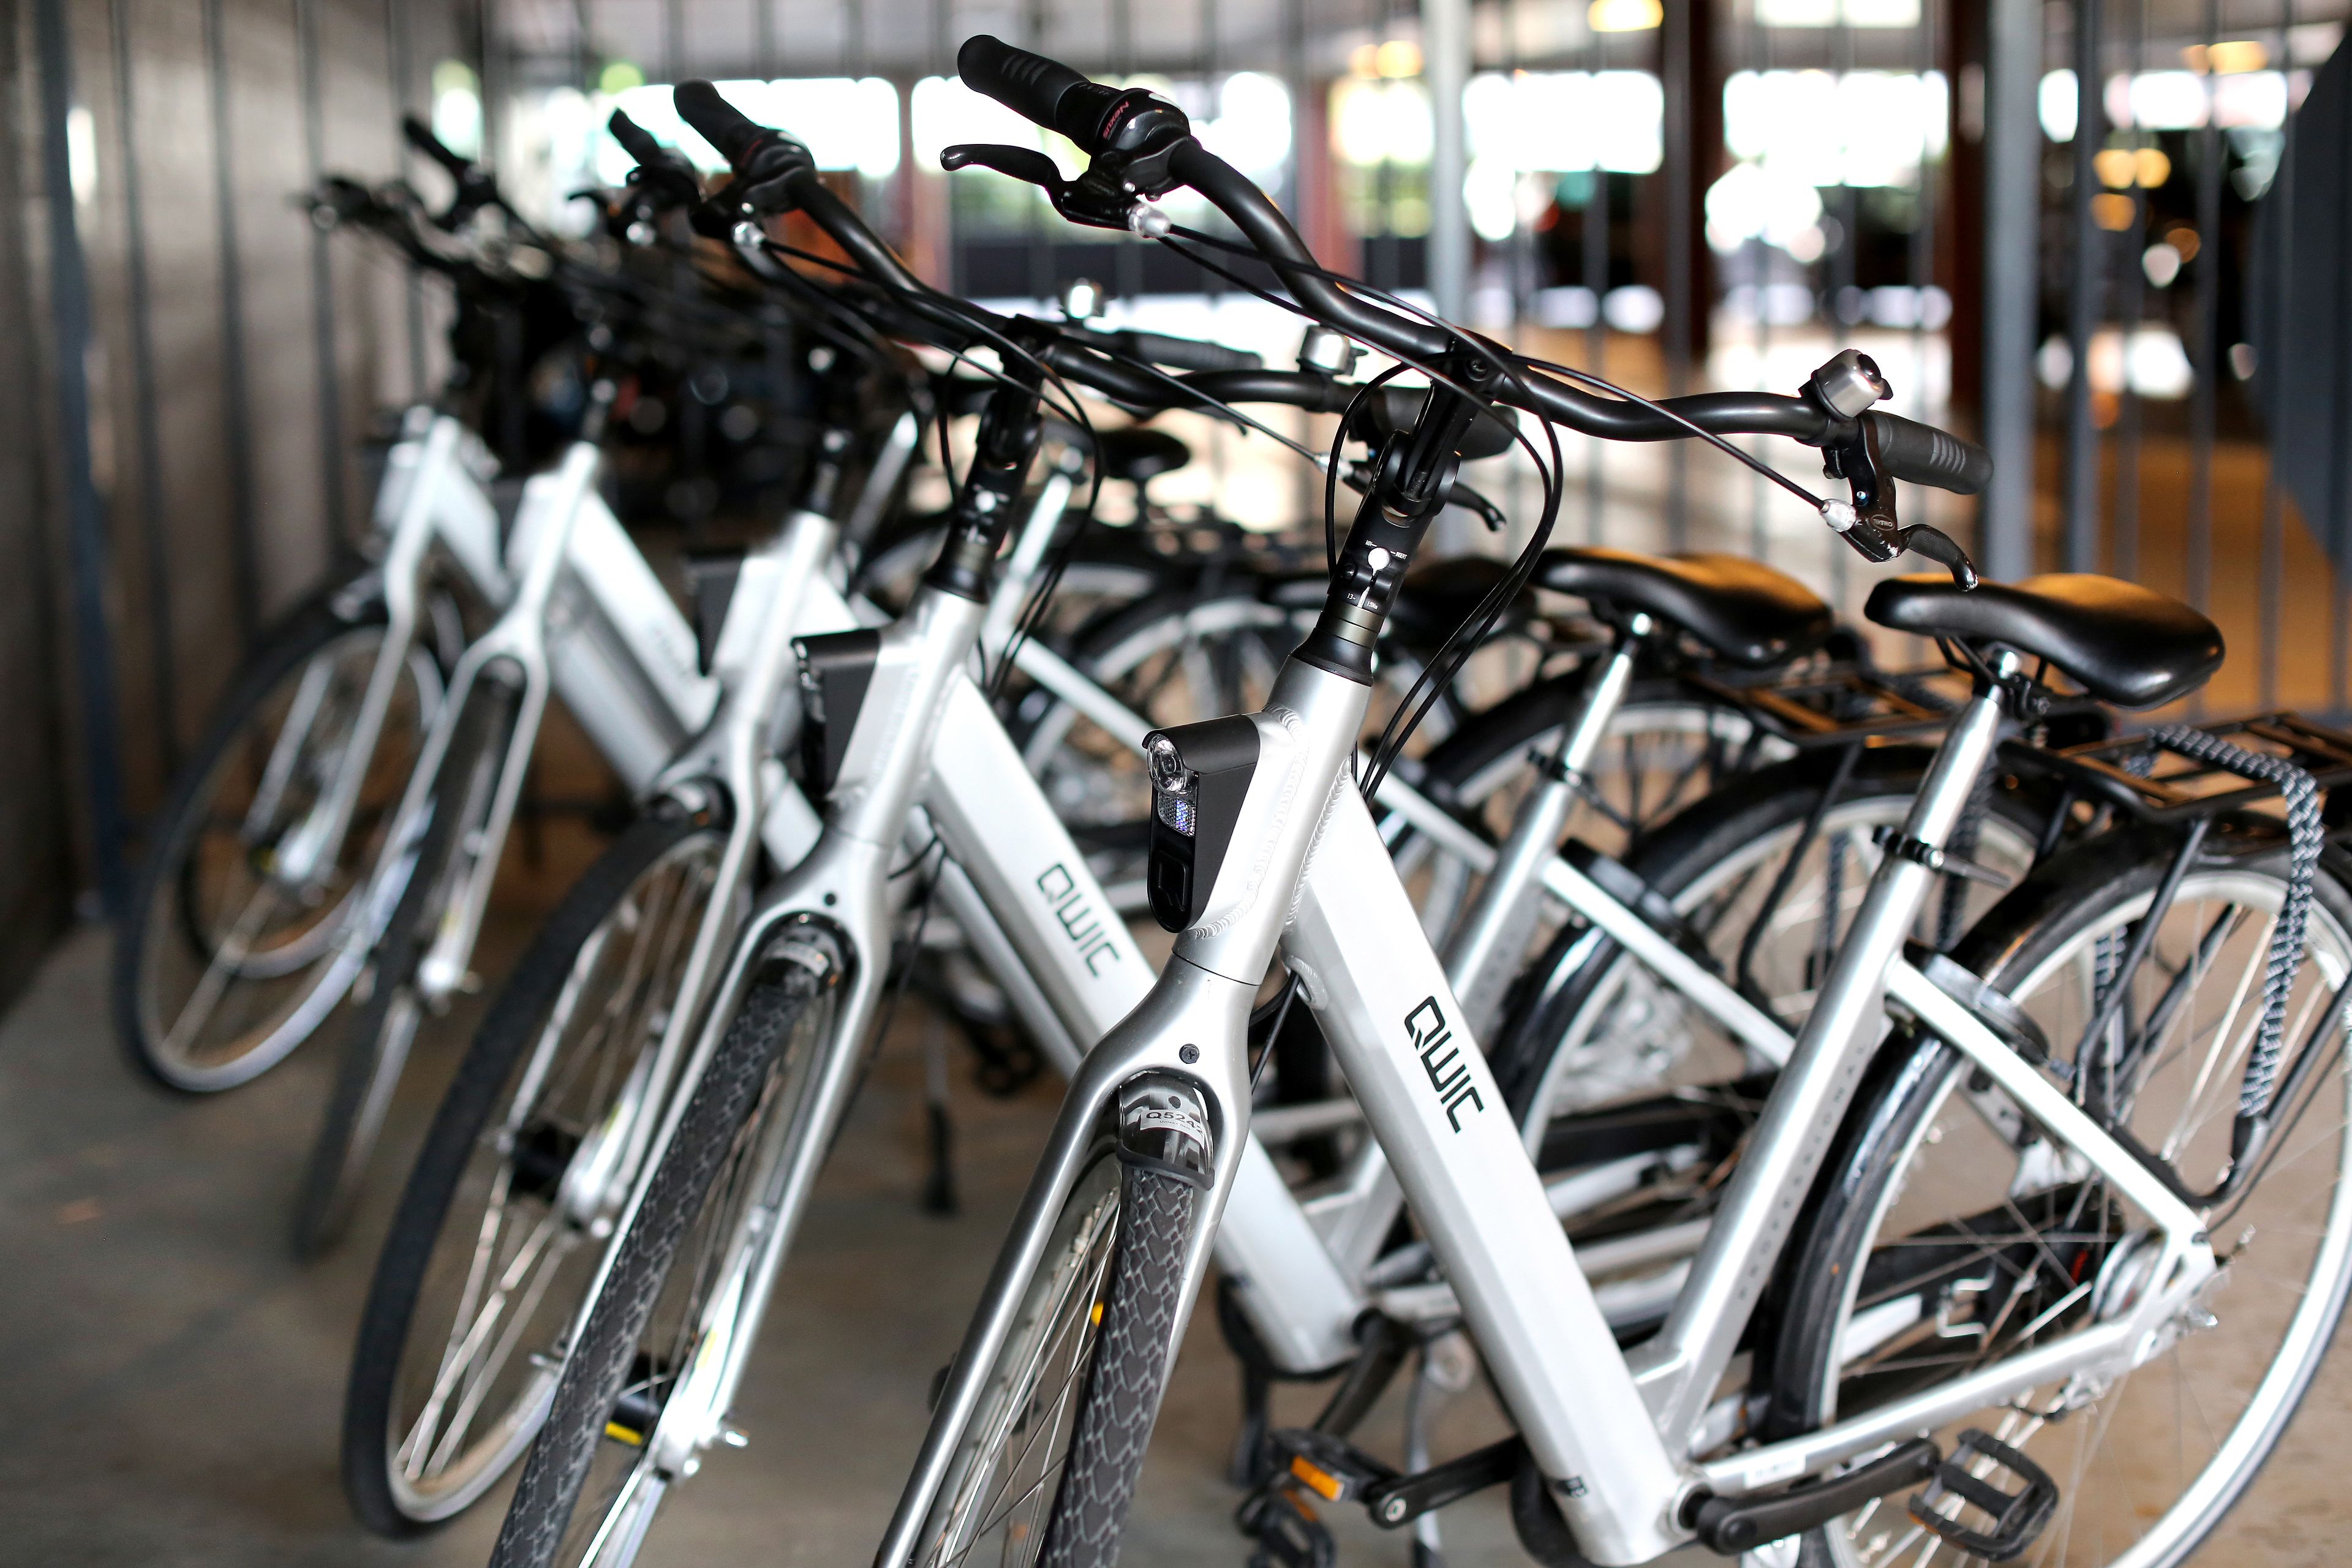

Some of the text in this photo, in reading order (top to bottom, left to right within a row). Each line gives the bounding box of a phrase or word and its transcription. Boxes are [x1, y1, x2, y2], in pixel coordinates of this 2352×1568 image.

[1395, 551, 1408, 560] INSERT
[1036, 862, 1120, 978] QWIC
[1404, 995, 1484, 1134] QWIC
